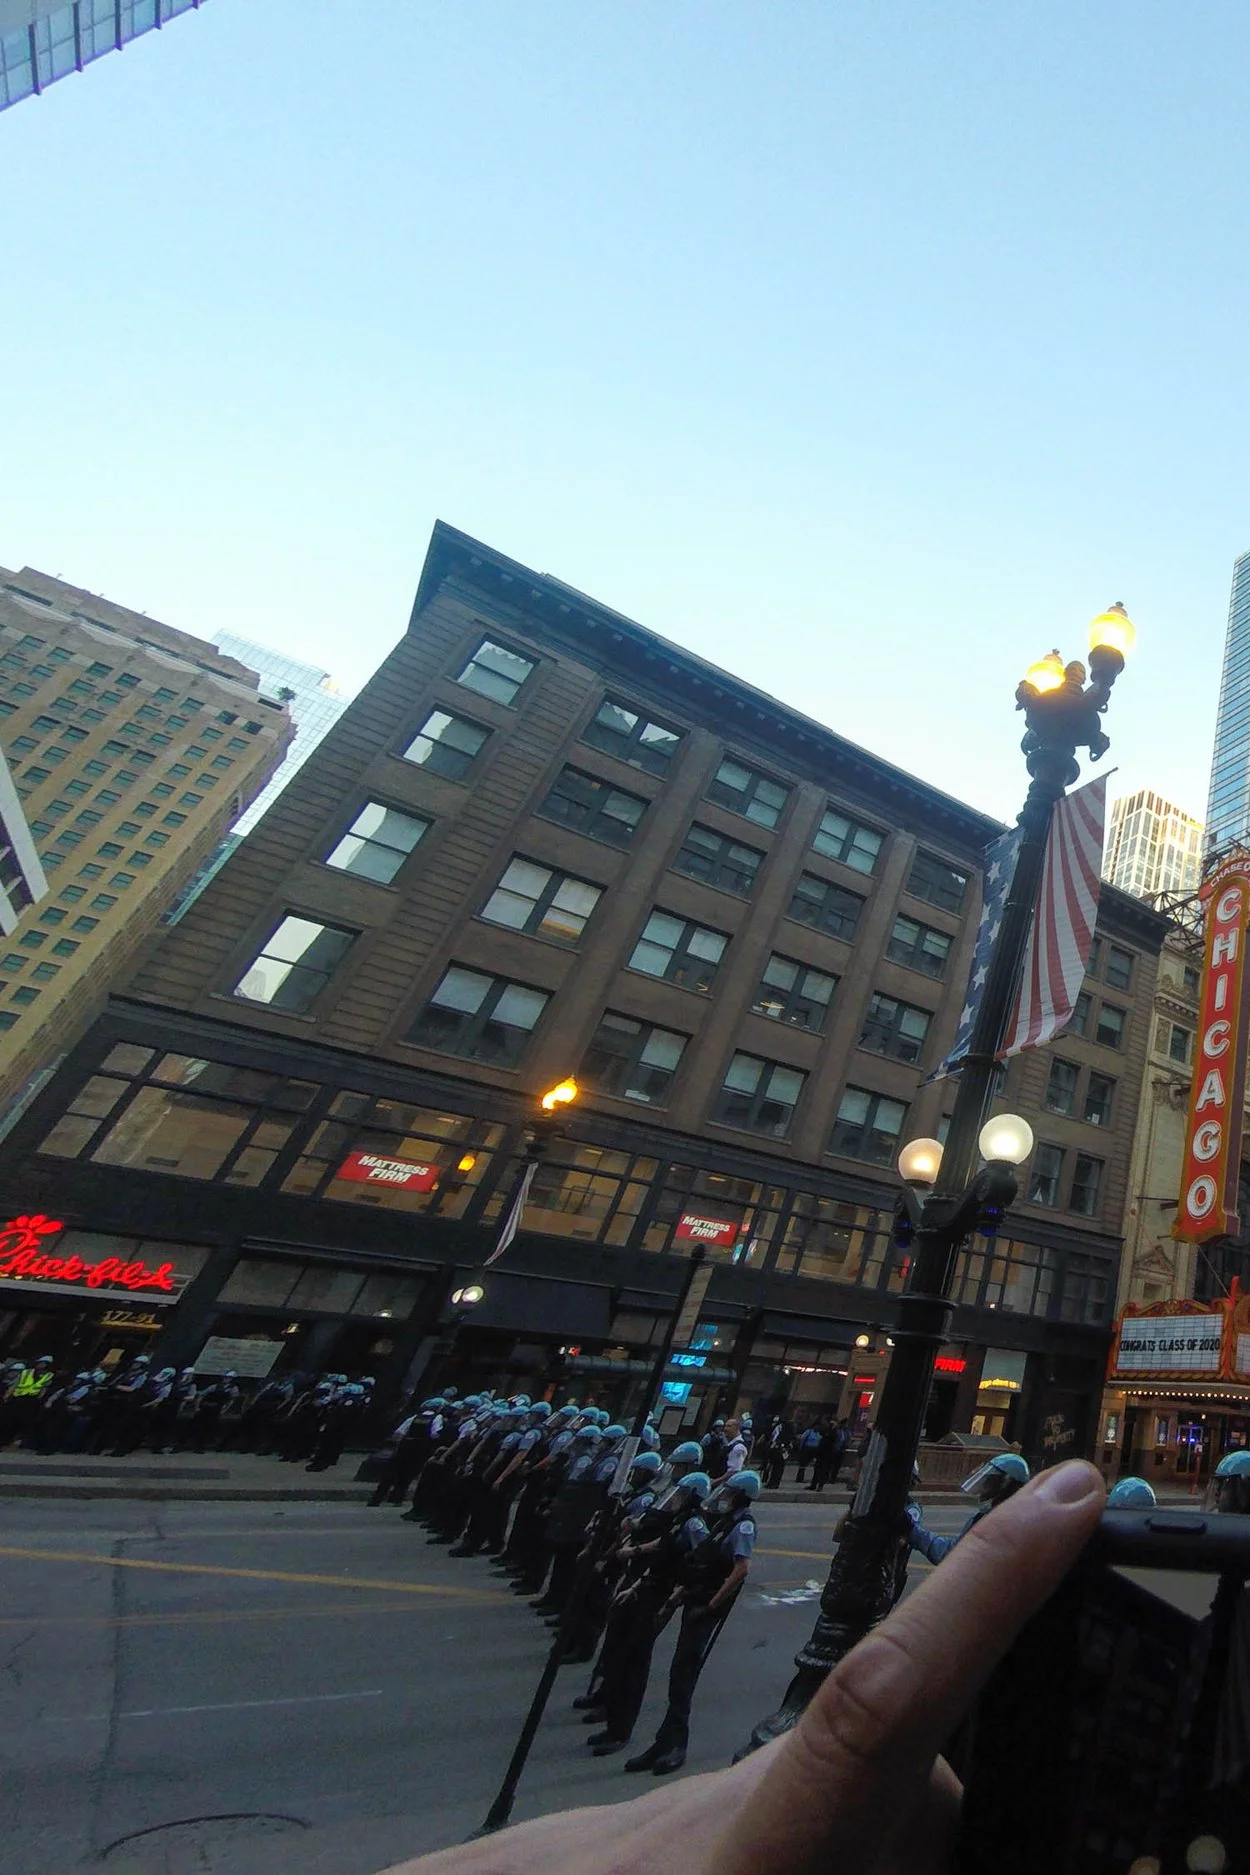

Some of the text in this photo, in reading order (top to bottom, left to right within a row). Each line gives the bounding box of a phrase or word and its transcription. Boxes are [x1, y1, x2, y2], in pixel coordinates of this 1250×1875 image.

[1210, 862, 1243, 887] CHASE
[1186, 887, 1242, 1220] CHICAGO
[357, 1155, 429, 1176] MATTRESS
[367, 1168, 412, 1183] FIRM
[682, 1216, 730, 1232] MATTRESS
[690, 1226, 719, 1239] FIRM
[1120, 1338, 1220, 1352] CONGRATS CLASS OF 2020
[934, 1357, 967, 1373] FIRM
